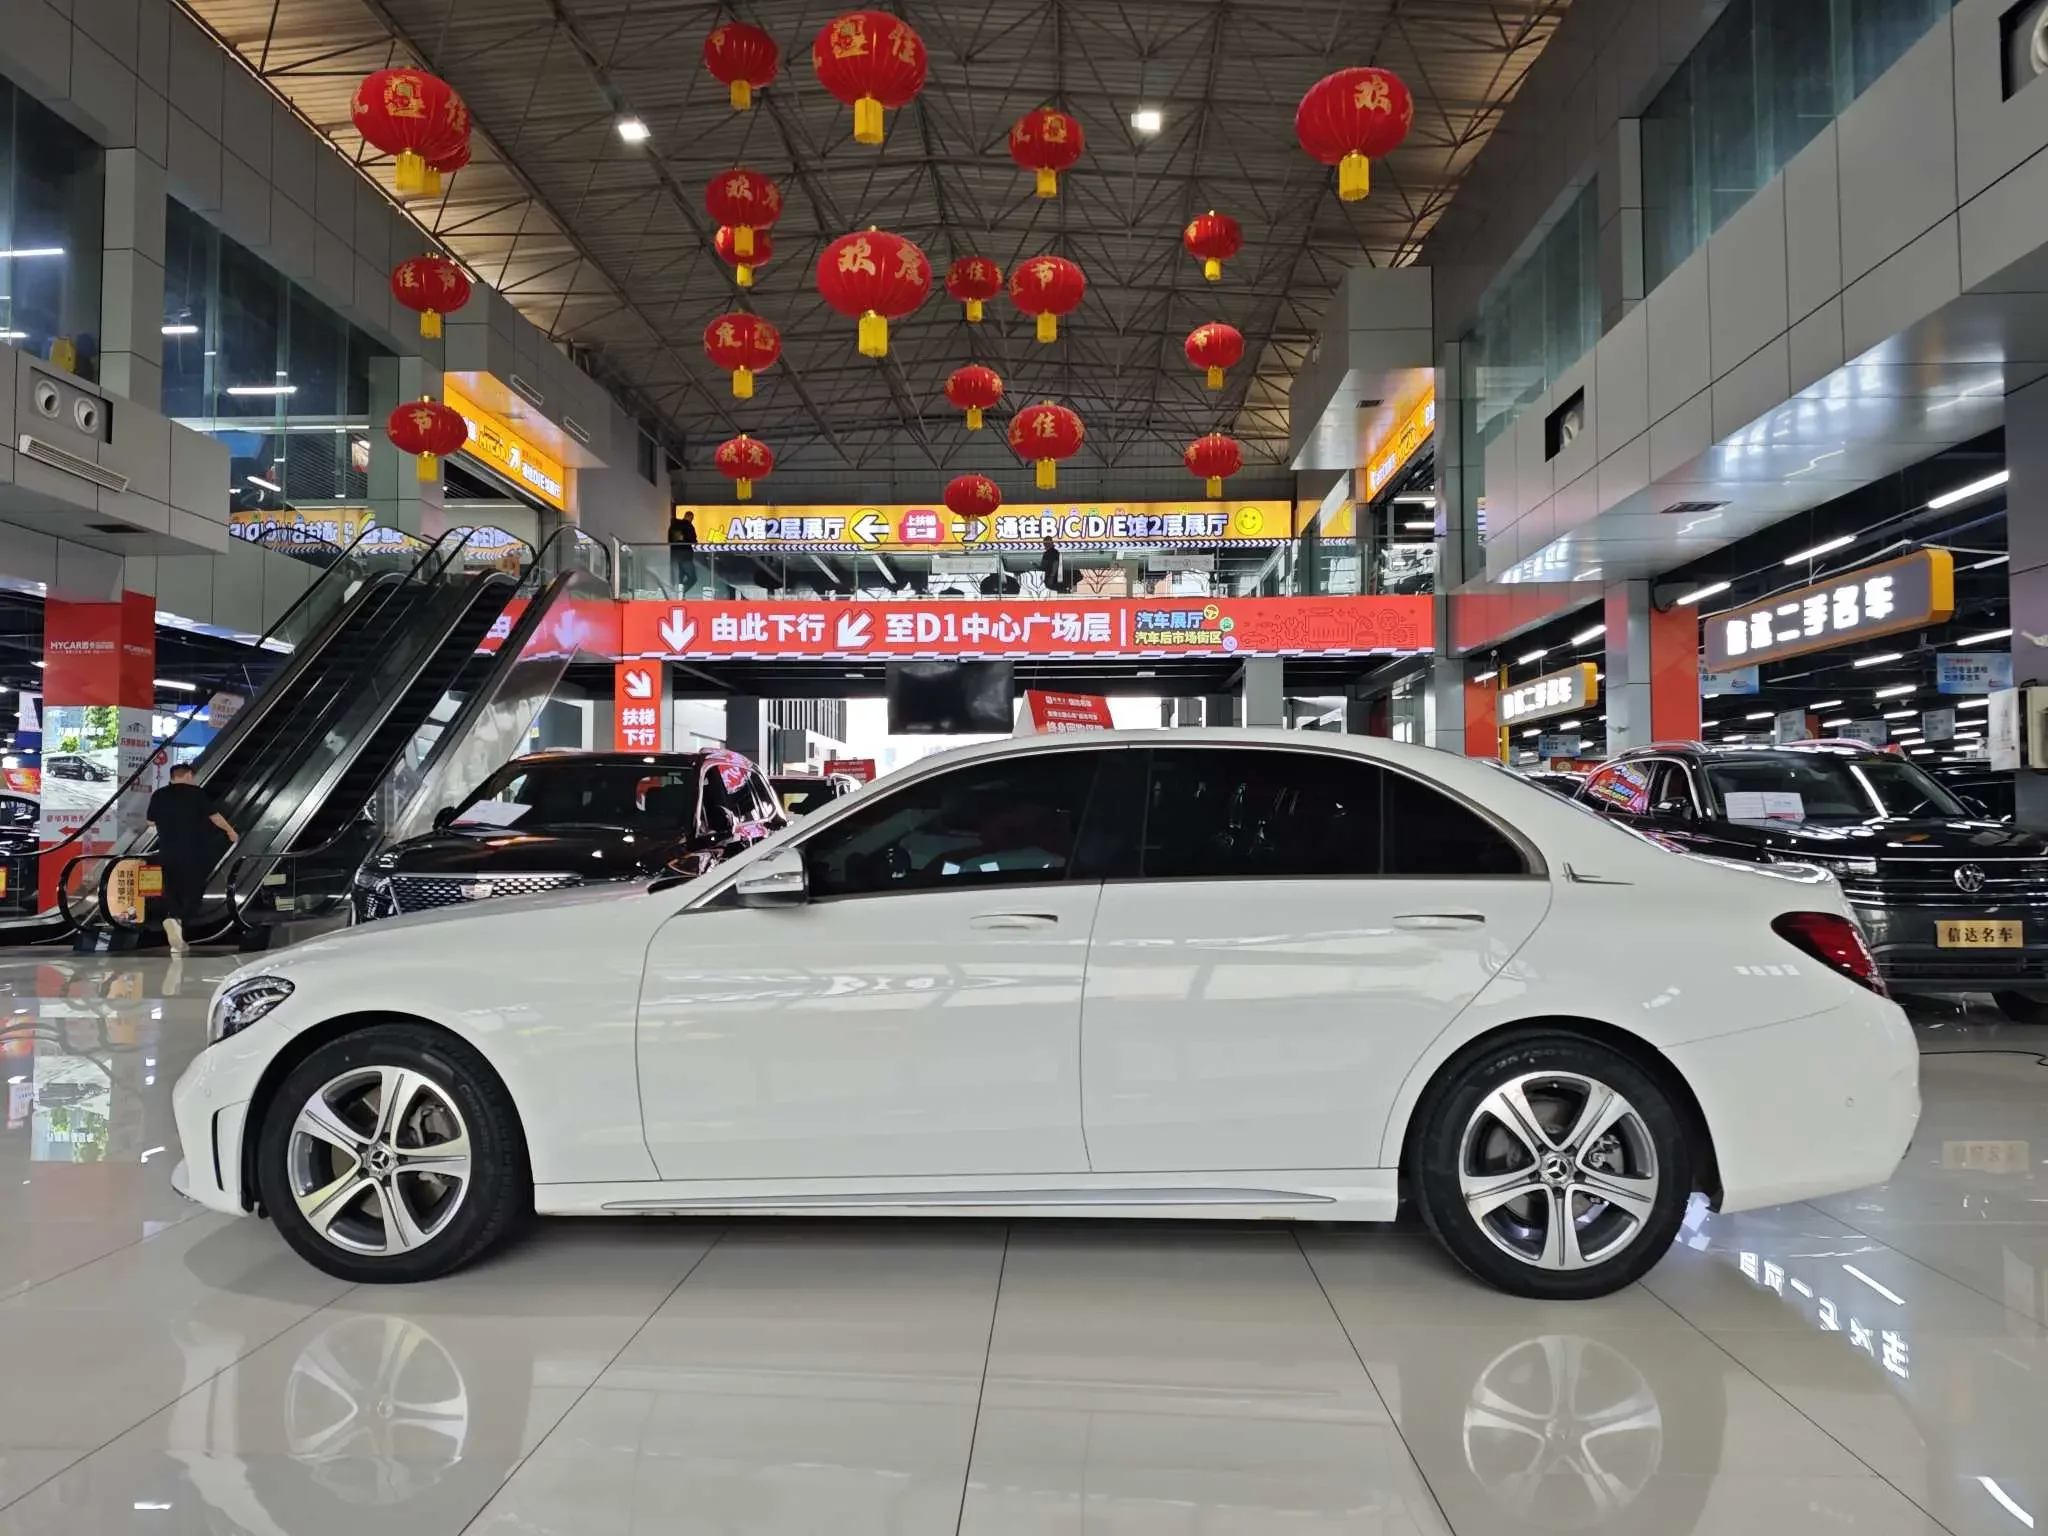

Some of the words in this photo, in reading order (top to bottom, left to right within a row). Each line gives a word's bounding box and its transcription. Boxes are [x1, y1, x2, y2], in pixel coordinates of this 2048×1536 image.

[727, 517, 845, 540] A馆2层展厅
[996, 514, 1228, 539] 通往B/C/D/E馆2层展厅
[711, 611, 825, 643] 由此下行
[885, 611, 1111, 644] 至D1中心广场层
[1136, 611, 1204, 629] 汽车展厅
[1135, 631, 1222, 645] 汽车后市场街区
[622, 707, 655, 726] 扶梯
[622, 728, 655, 746] 下行
[1948, 927, 2013, 943] 信达名车
